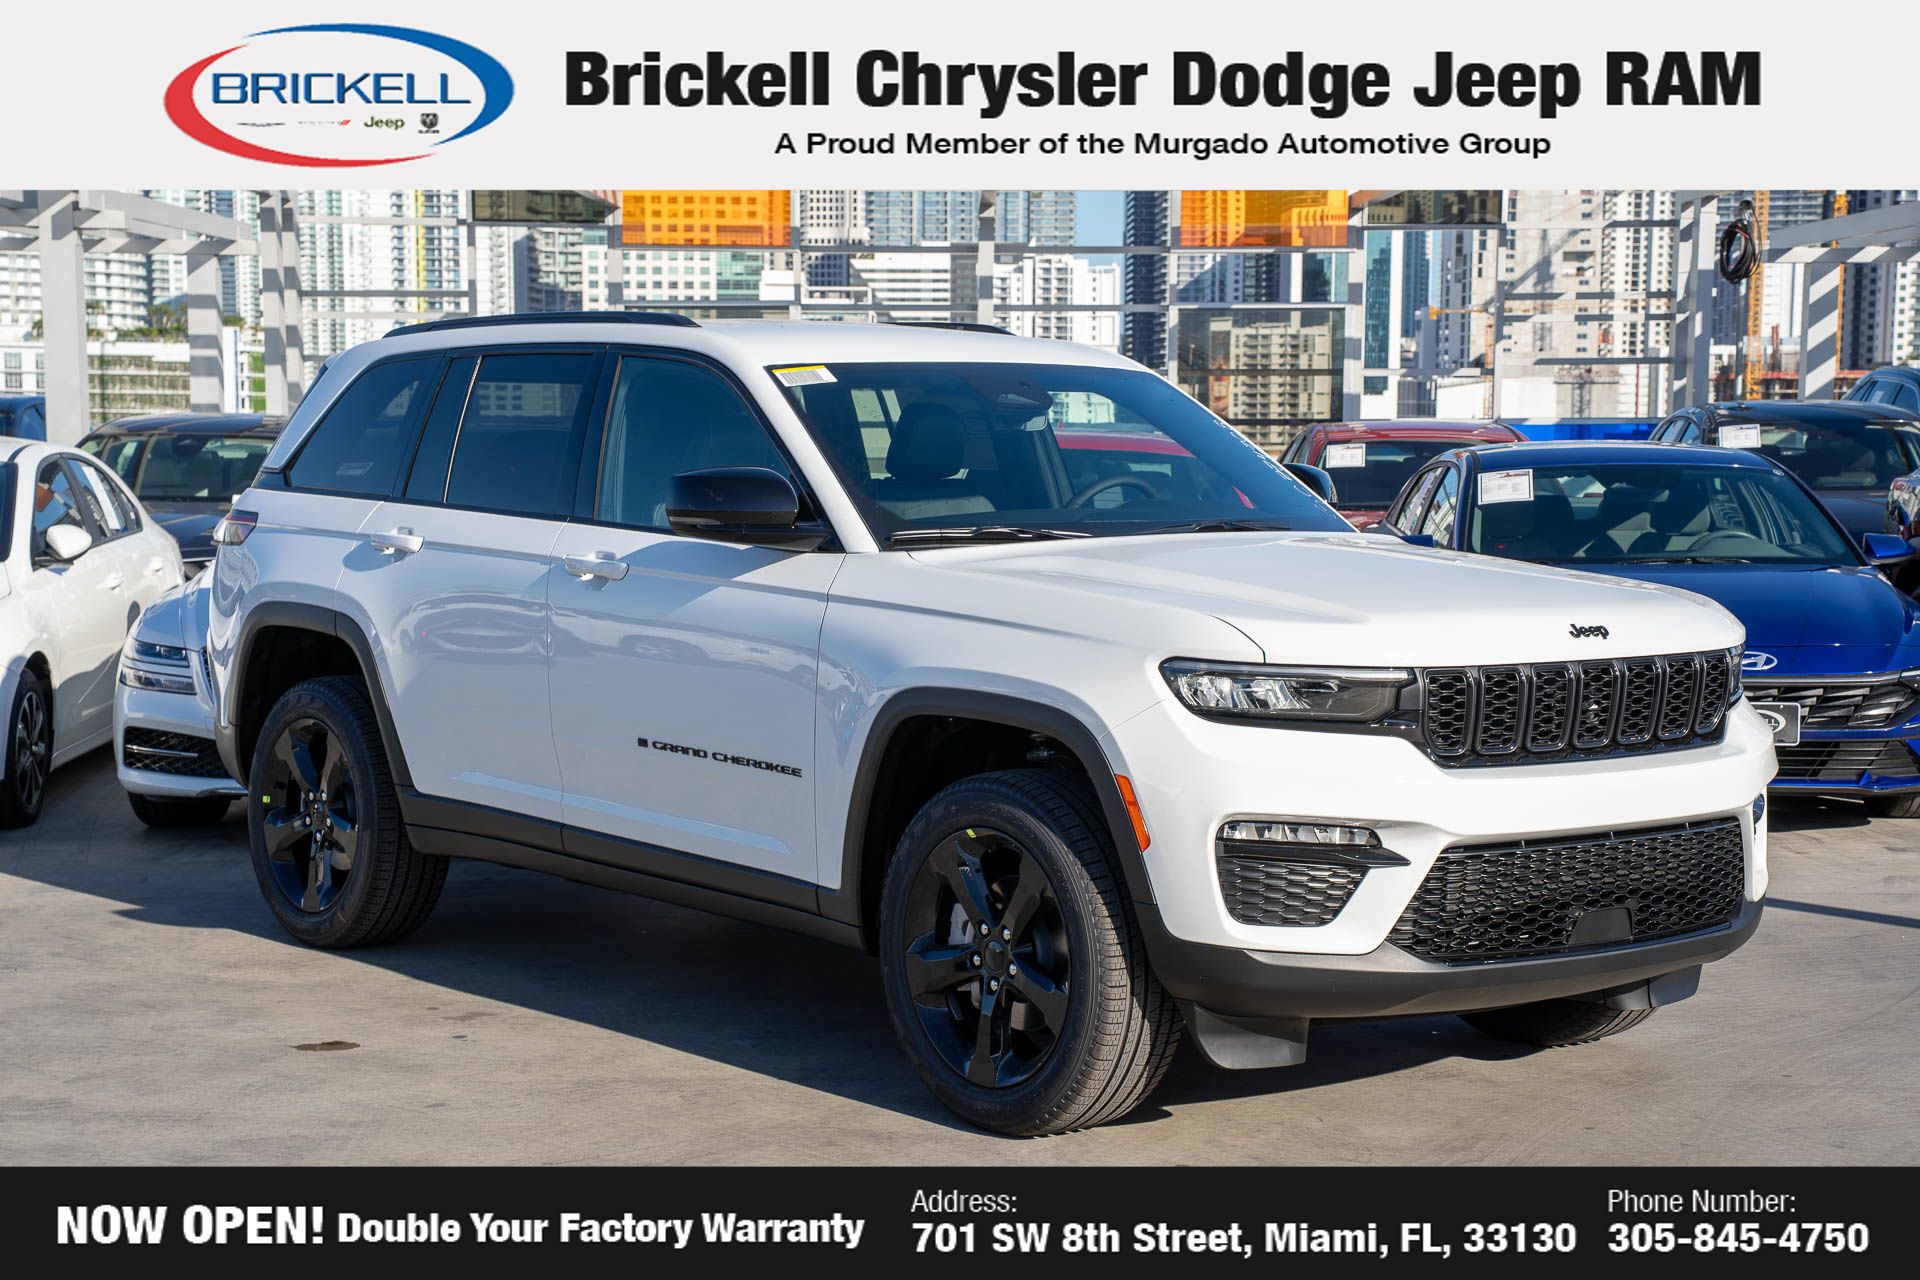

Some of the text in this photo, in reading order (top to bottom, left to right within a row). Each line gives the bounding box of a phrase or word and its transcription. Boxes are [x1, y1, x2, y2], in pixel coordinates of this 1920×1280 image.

[1569, 623, 1609, 640] Jeep
[652, 741, 803, 778] GRAND CHEROKEE
